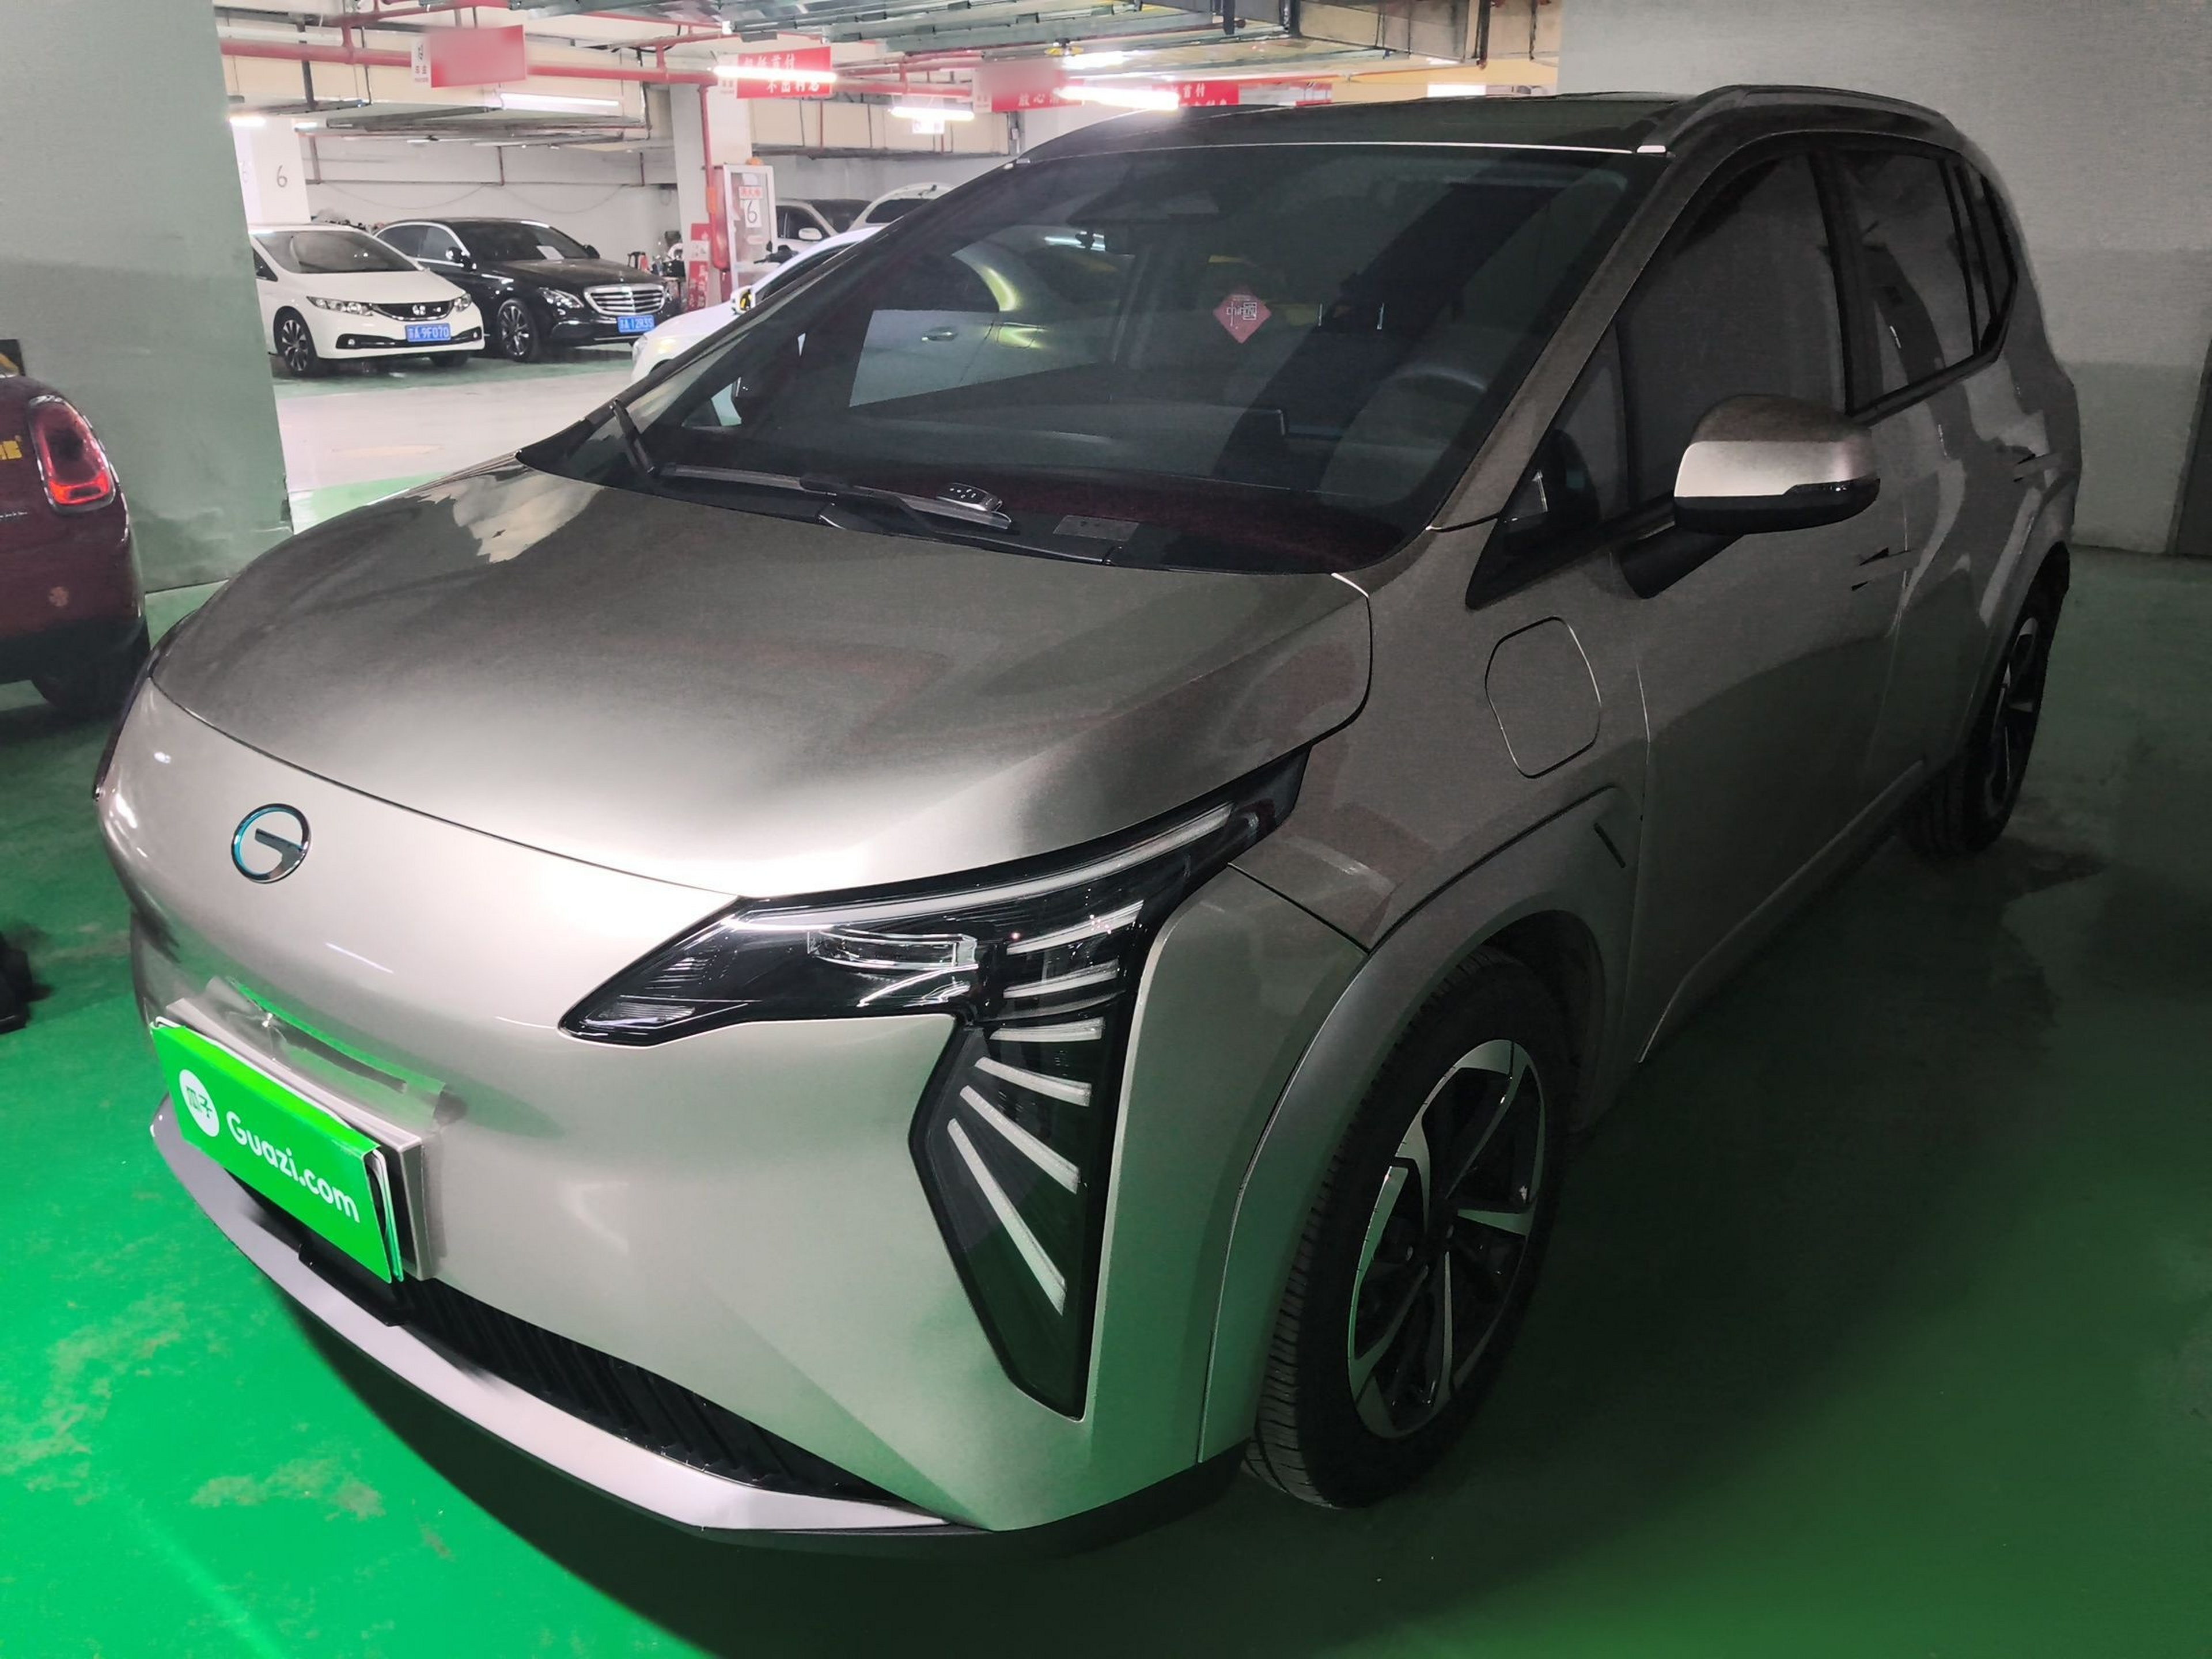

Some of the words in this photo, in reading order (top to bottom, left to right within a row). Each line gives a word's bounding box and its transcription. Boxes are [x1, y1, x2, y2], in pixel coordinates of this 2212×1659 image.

[276, 165, 287, 188] 6
[747, 200, 757, 224] 6
[226, 1111, 360, 1223] Guazi.com
